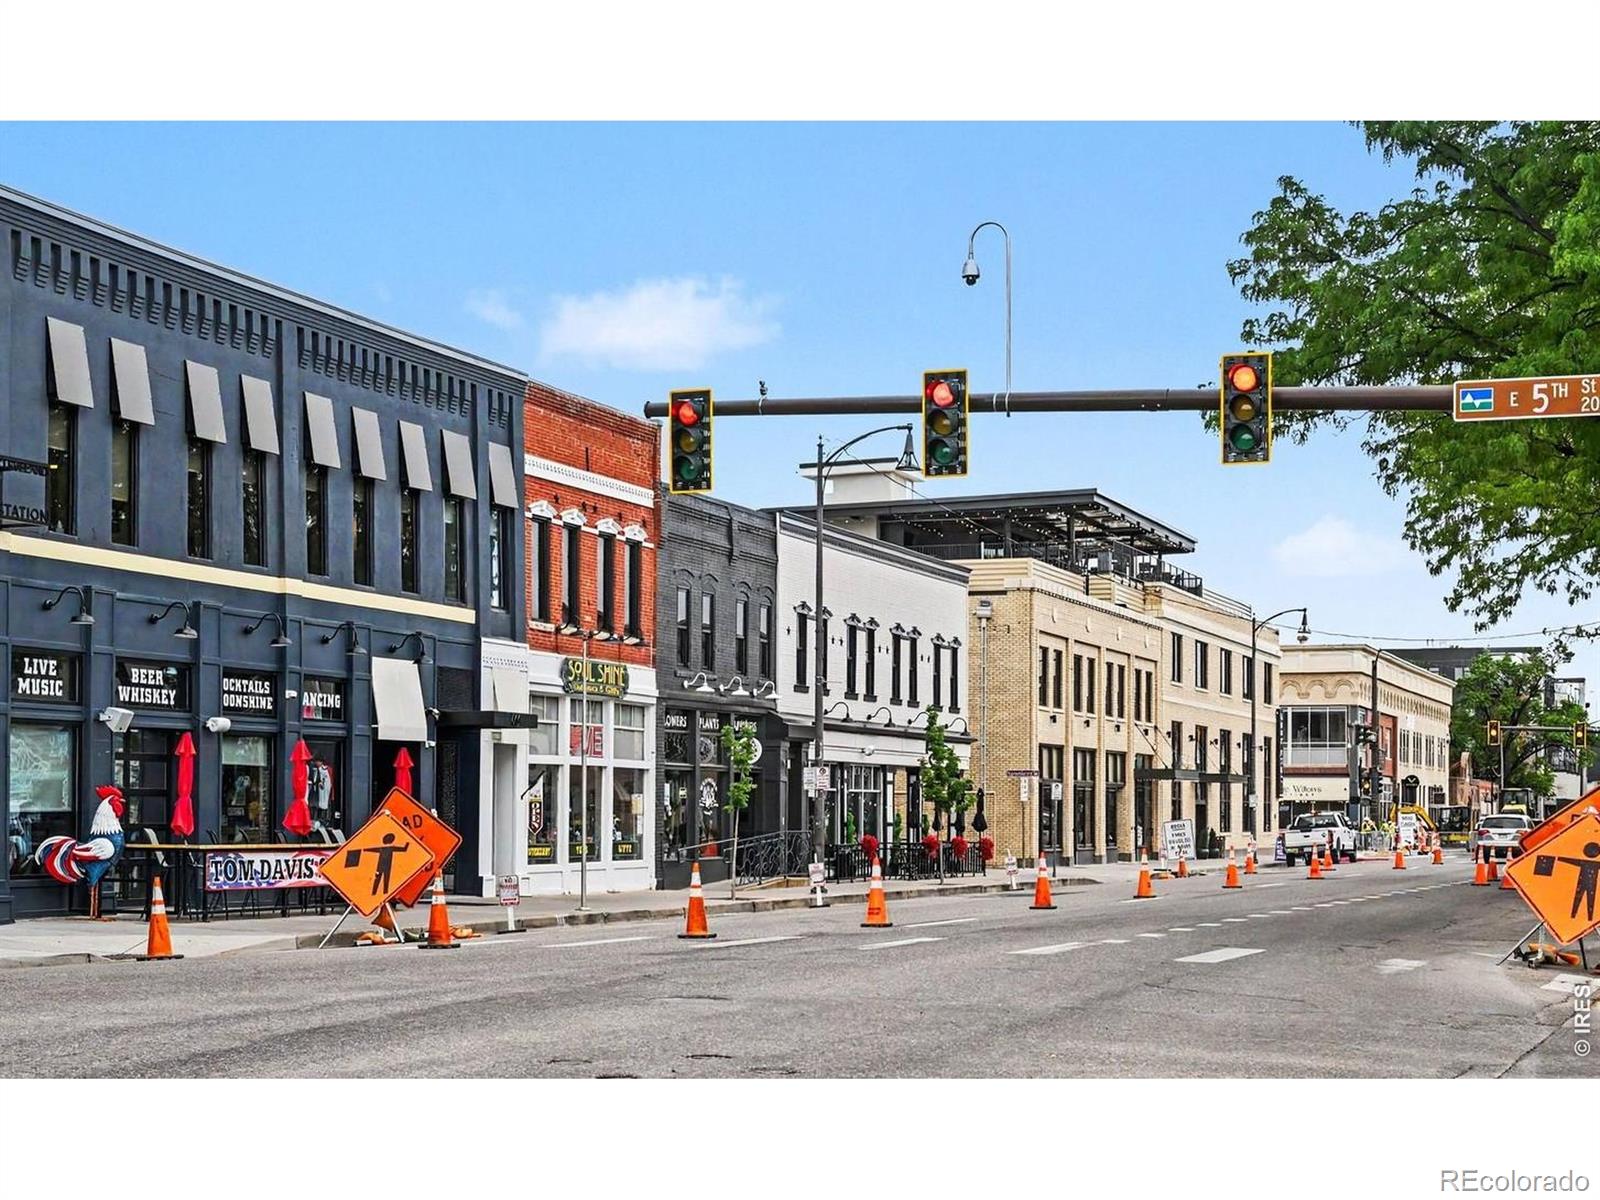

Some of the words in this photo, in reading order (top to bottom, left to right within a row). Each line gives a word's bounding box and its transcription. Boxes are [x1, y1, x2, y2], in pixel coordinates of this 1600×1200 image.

[1581, 379, 1597, 394] St
[1510, 392, 1519, 407] E
[1533, 383, 1568, 413] 5TH
[23, 657, 58, 676] LIVE
[131, 667, 164, 686] BEER
[17, 677, 63, 697] MUSIC
[117, 685, 177, 706] WHISKEY
[211, 859, 254, 882] TOM
